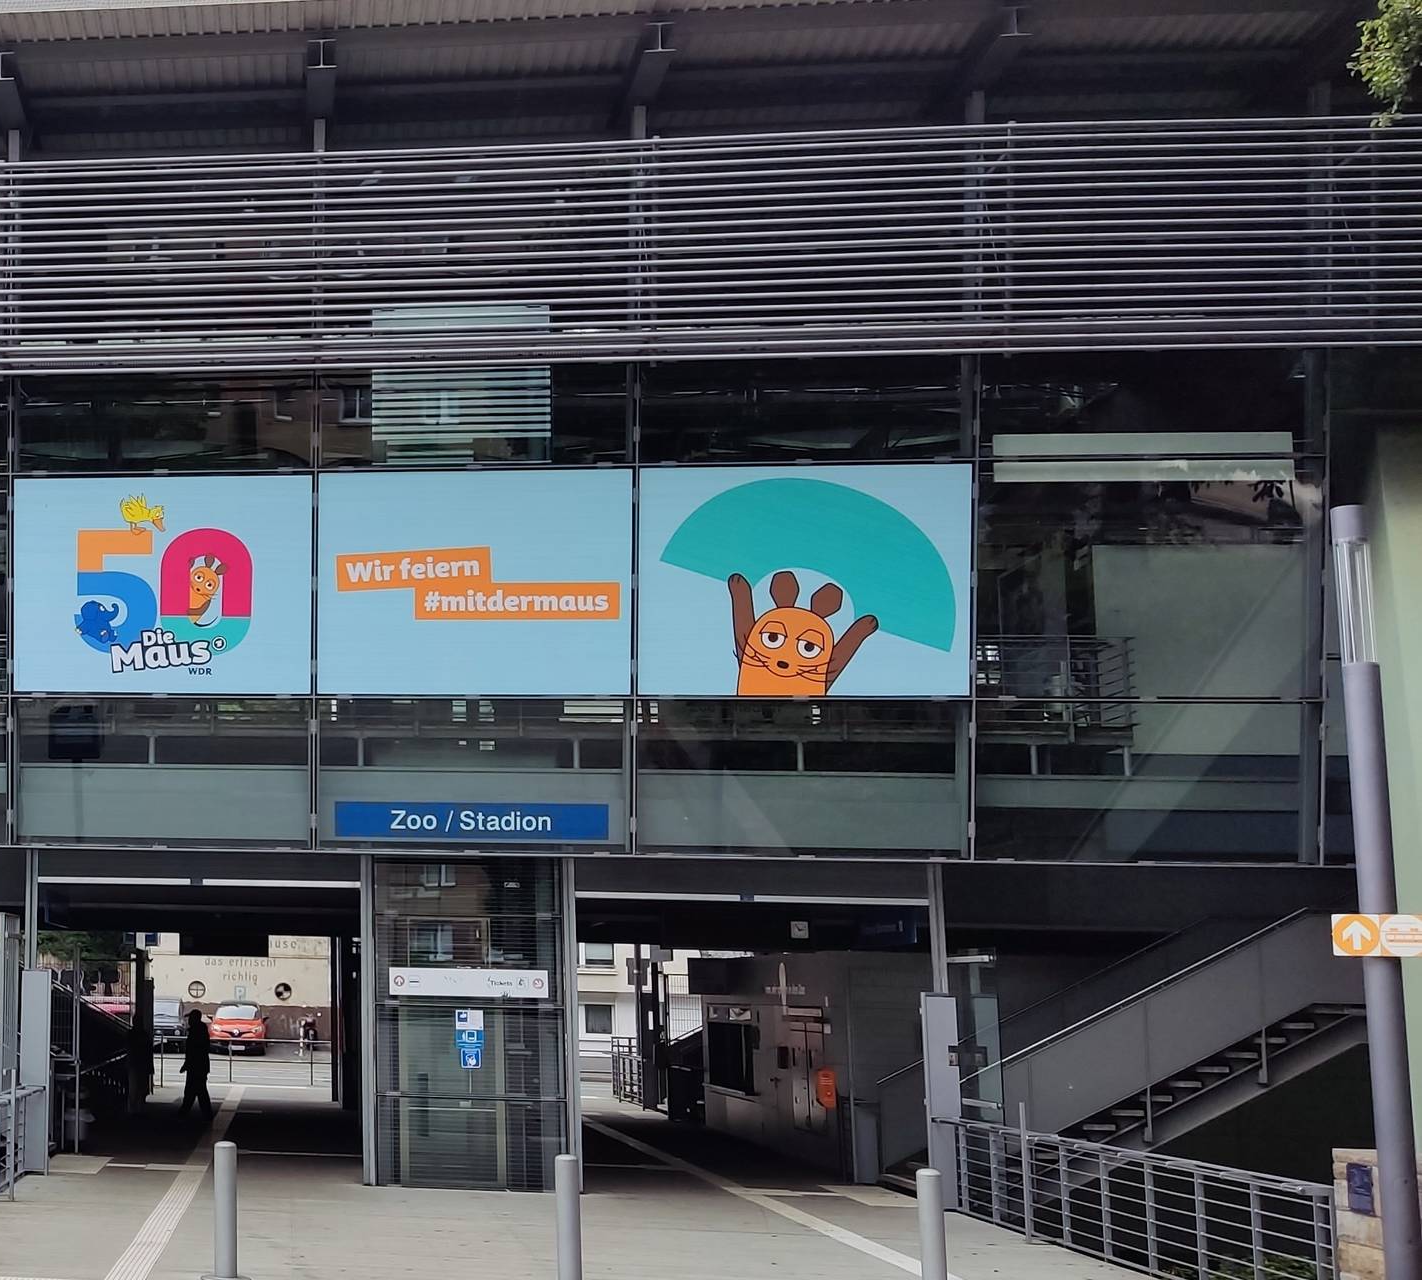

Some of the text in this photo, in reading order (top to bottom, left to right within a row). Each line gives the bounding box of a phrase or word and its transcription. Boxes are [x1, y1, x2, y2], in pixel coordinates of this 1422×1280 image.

[345, 556, 480, 583] Wir feiern
[75, 528, 253, 655] 50
[424, 590, 609, 612] #mitdermaus
[141, 628, 175, 648] Die
[111, 640, 212, 673] Maus
[188, 667, 213, 676] WDR
[389, 809, 552, 832] Zoo / Stadion
[204, 957, 223, 967] das
